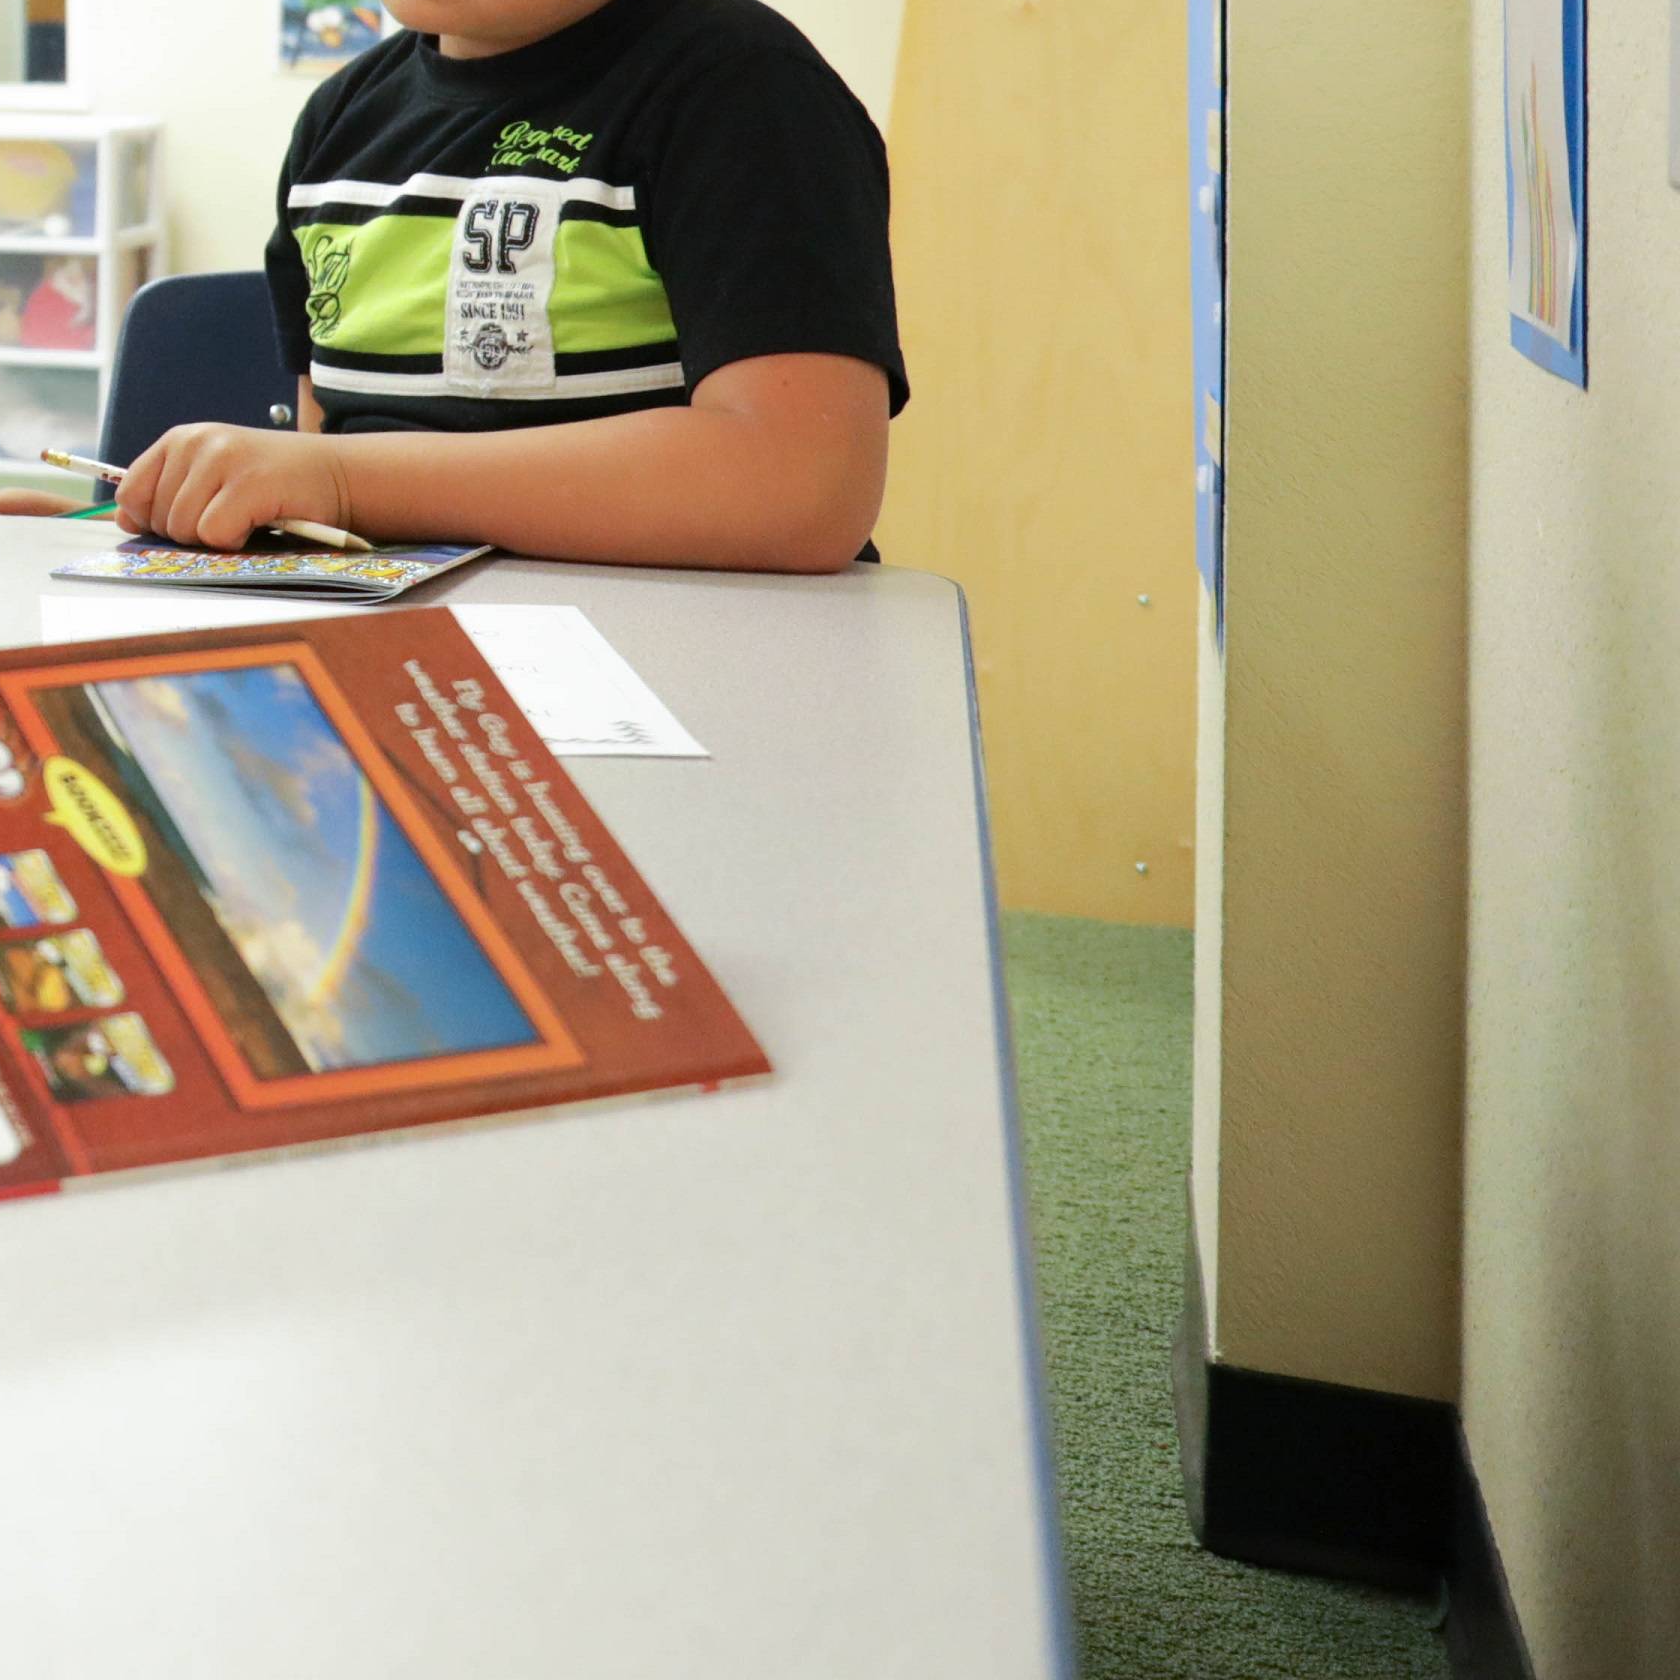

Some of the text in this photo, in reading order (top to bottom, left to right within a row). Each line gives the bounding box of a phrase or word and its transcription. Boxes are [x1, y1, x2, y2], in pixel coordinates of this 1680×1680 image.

[462, 199, 541, 275] SP
[460, 302, 497, 319] SINCE
[403, 659, 470, 740] weather
[559, 883, 614, 951] Come
[605, 953, 663, 1021] along
[471, 817, 530, 878] about
[639, 945, 677, 987] the
